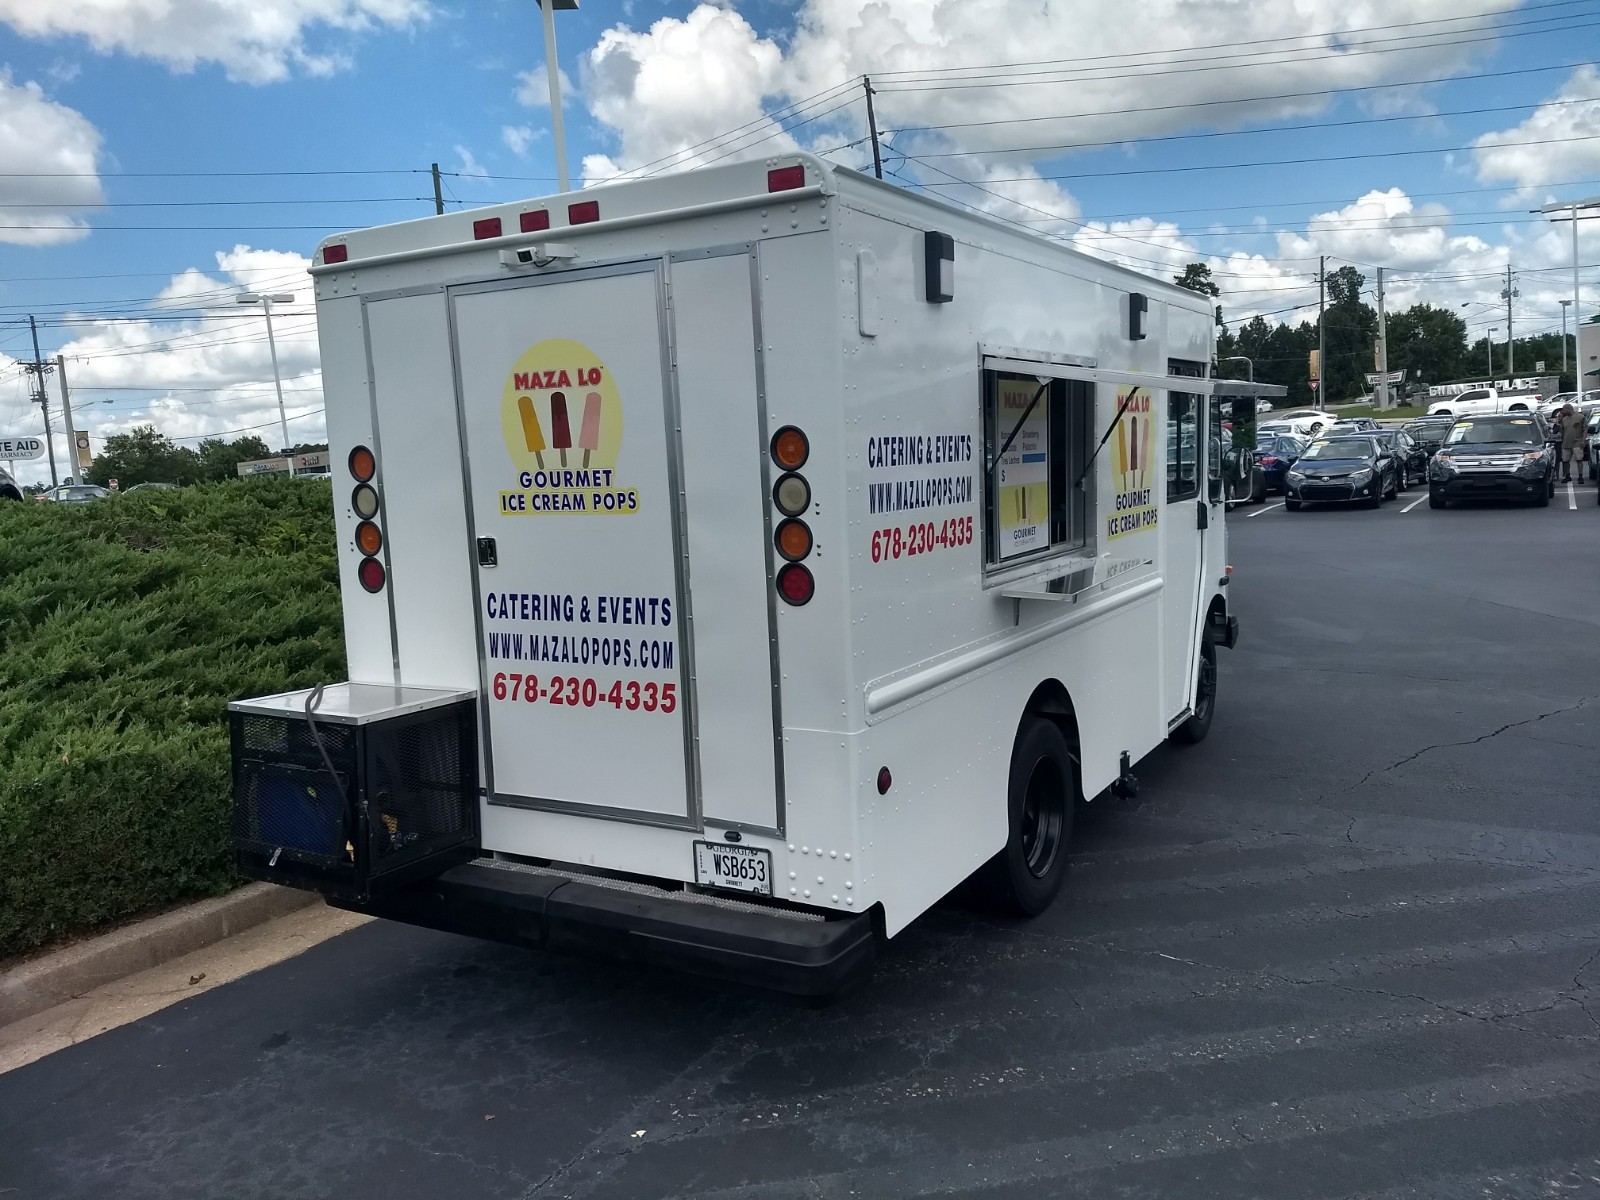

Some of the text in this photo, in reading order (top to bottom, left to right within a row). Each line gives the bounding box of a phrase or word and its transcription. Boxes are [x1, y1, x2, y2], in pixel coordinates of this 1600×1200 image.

[514, 367, 602, 390] MAZA LO
[1117, 395, 1140, 412] MZA
[16, 440, 39, 451] AID
[868, 434, 971, 468] CATERING & EVENTS
[519, 470, 612, 488] GOURMET
[502, 491, 637, 511] ICE CREAM POPS
[869, 476, 972, 514] WWW.MAZALOPOPS.COM
[1116, 489, 1150, 511] GOURMET
[1013, 526, 1036, 539] GOURMET
[1108, 509, 1158, 536] ICE CREAM POPS
[871, 516, 973, 563] 678-230-4335
[487, 592, 672, 626] CATERING & EVENTS
[489, 632, 673, 669] WWW.MAZALOPOPS.COM
[493, 672, 676, 713] 678-230-4335
[713, 854, 765, 882] WSB653
